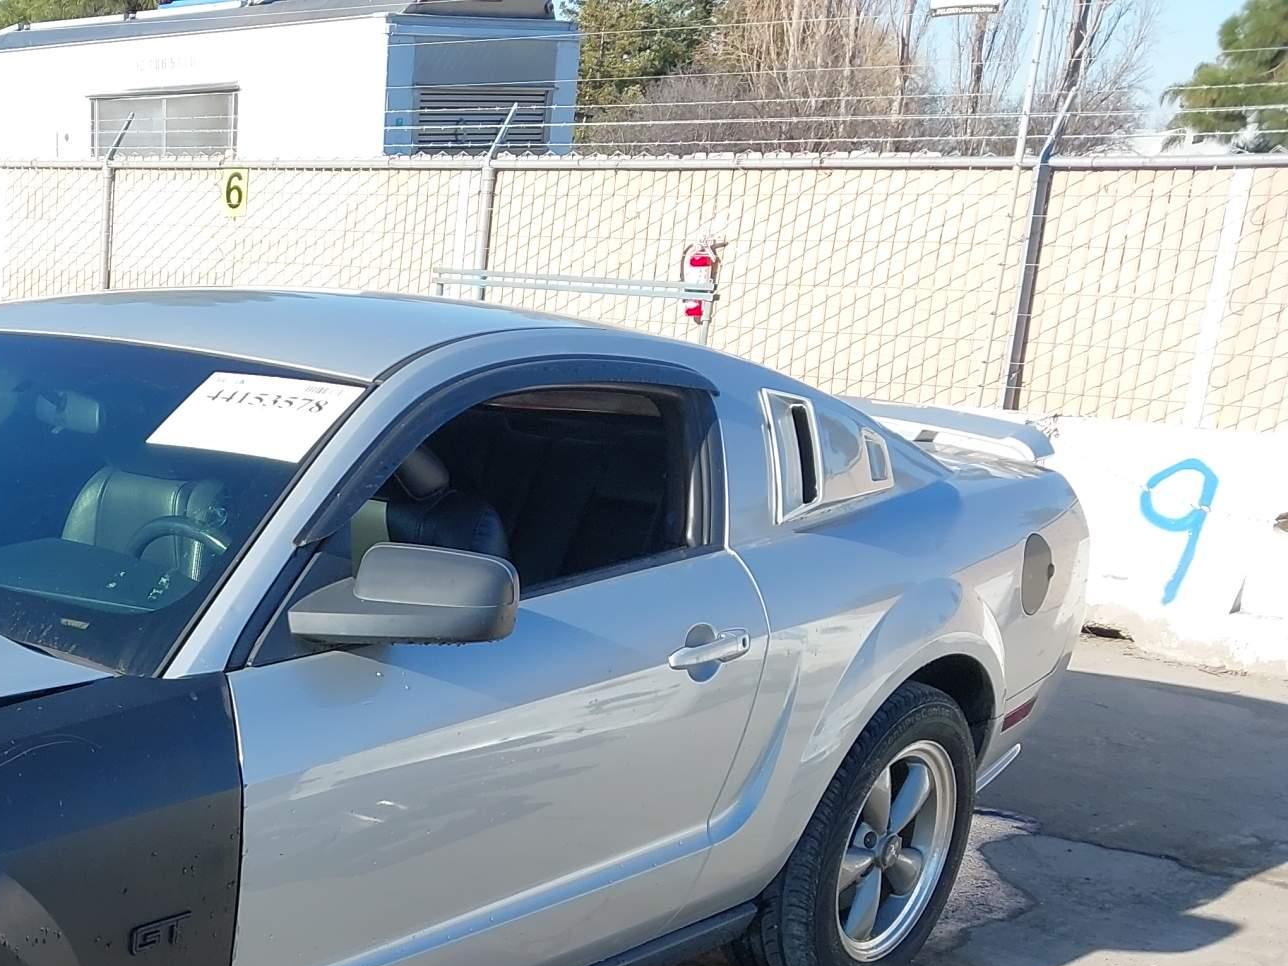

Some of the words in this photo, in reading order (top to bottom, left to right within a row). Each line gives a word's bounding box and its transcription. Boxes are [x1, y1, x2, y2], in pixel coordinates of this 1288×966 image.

[226, 172, 243, 209] 6
[207, 389, 329, 413] 44153578
[1140, 458, 1219, 605] 9
[128, 910, 193, 956] GT
